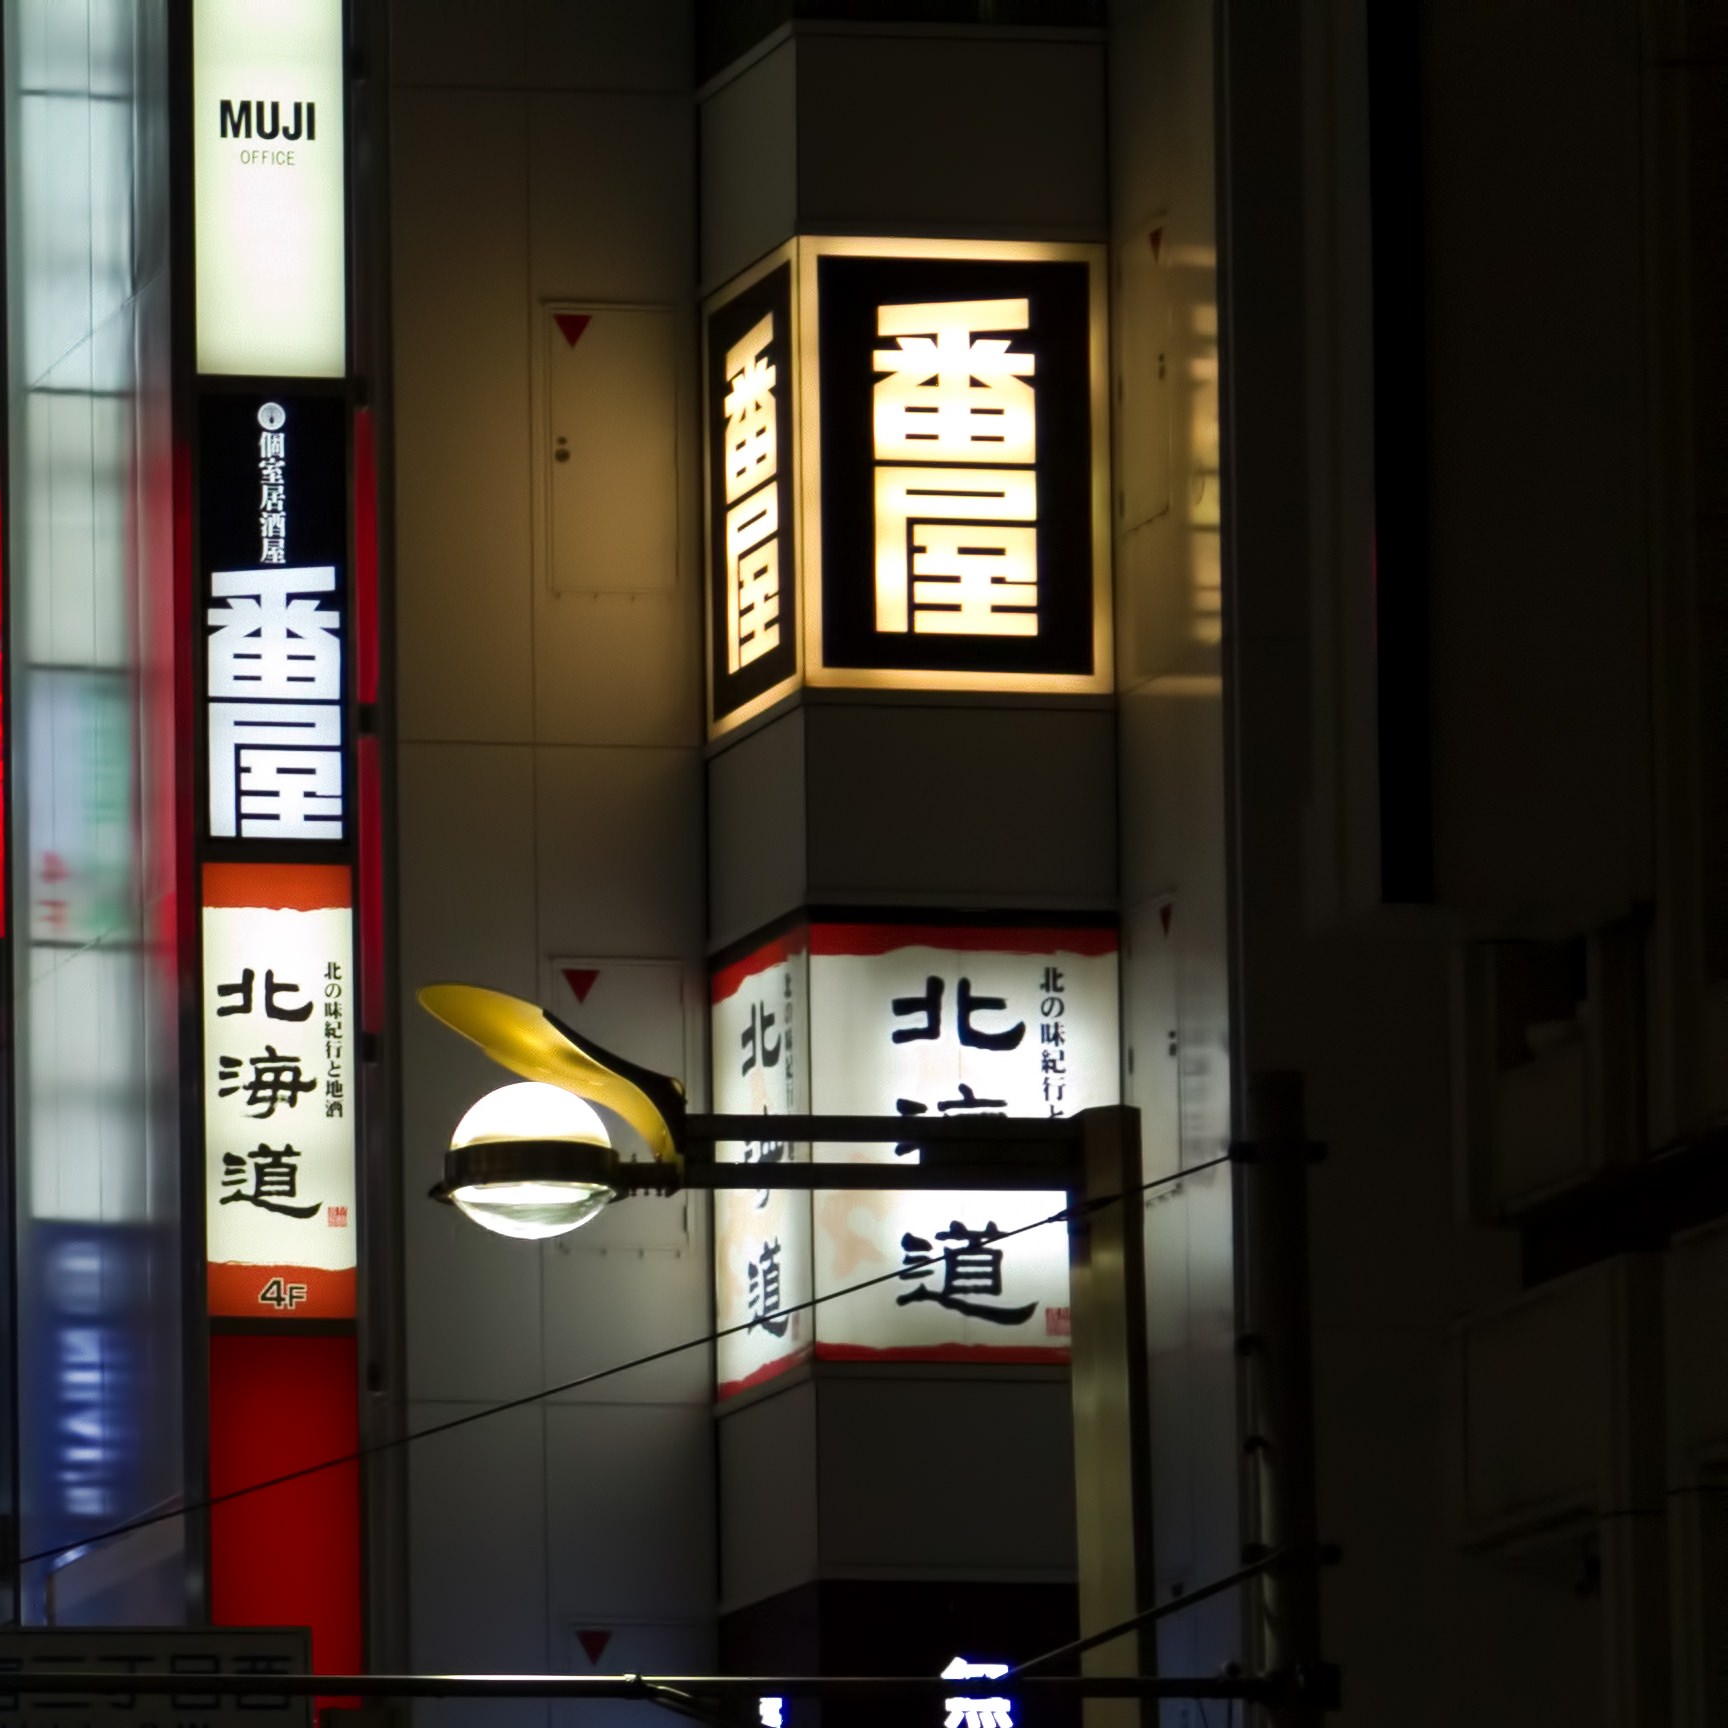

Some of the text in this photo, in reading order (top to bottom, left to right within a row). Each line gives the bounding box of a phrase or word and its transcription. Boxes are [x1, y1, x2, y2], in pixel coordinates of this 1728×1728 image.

[219, 100, 316, 142] MUJI
[239, 150, 295, 167] OFFICE
[259, 431, 286, 564] 個室居酒屋
[724, 311, 780, 675] 番屋
[872, 297, 1038, 636] 番屋
[207, 566, 342, 839] 番屋
[216, 967, 324, 1218] 北海道
[257, 1276, 307, 1310] 4F
